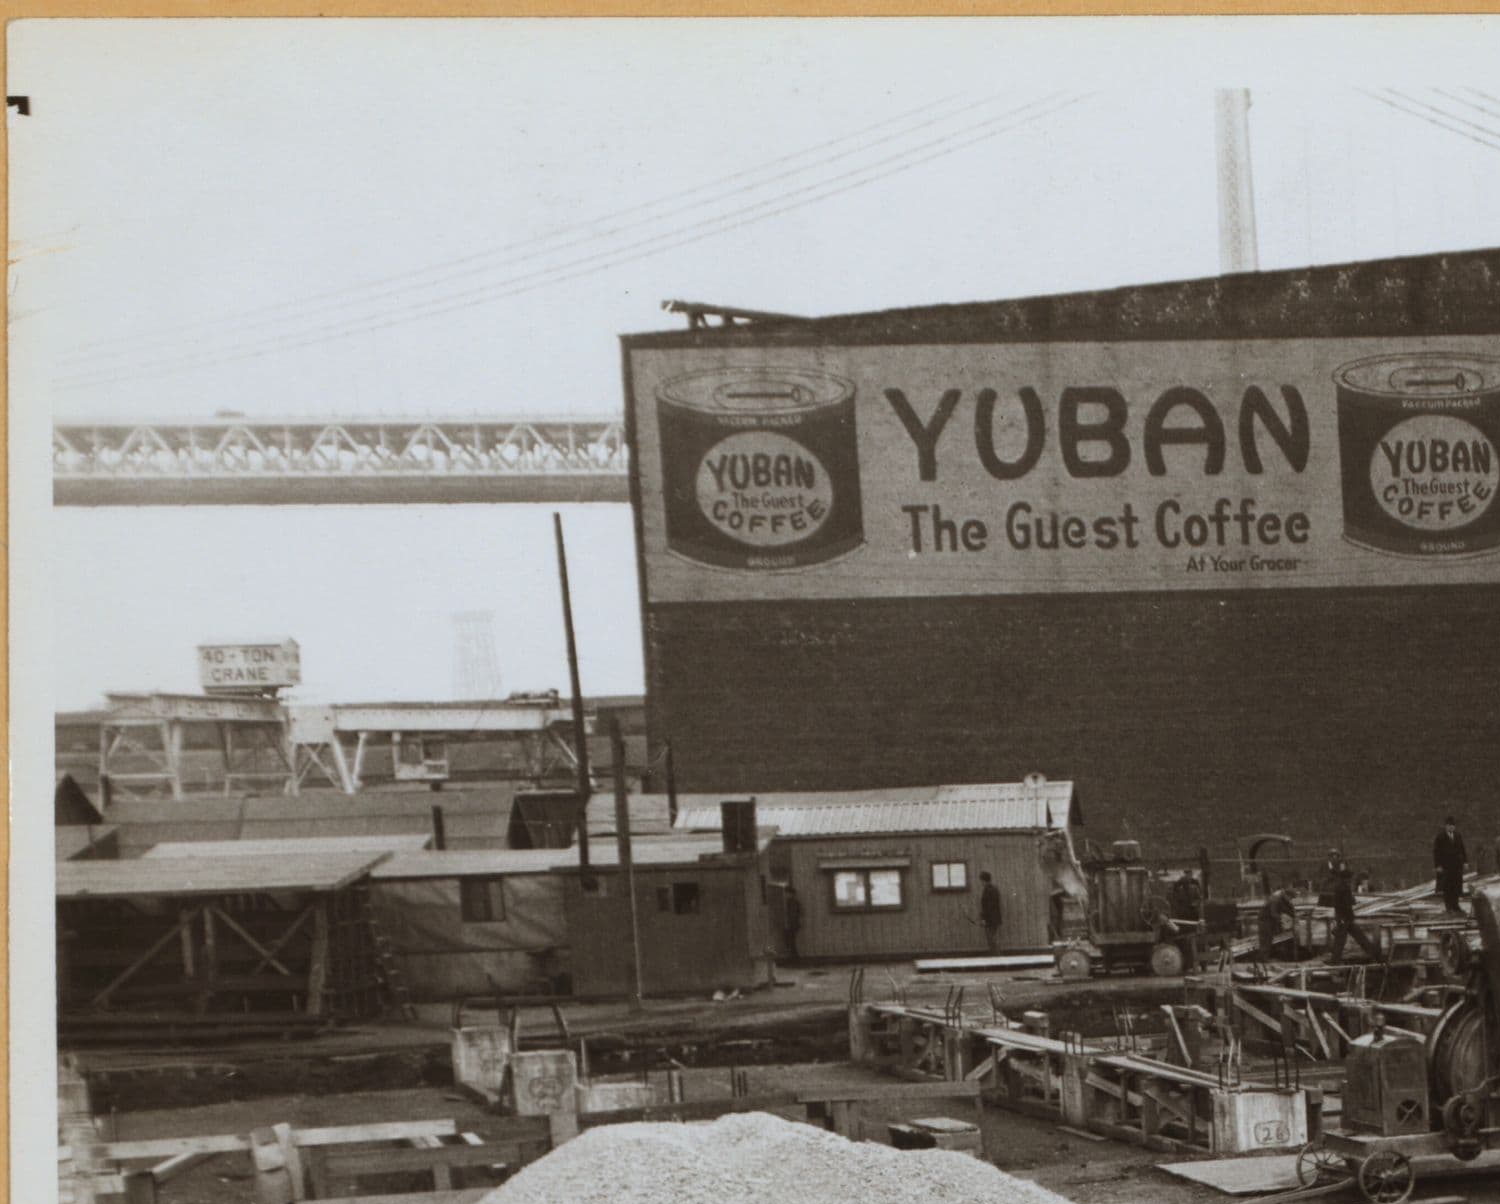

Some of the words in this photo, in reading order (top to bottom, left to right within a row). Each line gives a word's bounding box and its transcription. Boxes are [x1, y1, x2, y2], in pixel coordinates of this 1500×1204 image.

[883, 383, 1310, 482] YUBAN
[706, 453, 815, 493] YUBAN
[1380, 439, 1491, 478] YUBAN
[732, 492, 759, 509] The
[761, 491, 803, 509] Guest
[1383, 481, 1492, 521] COFFEE
[1402, 478, 1428, 495] The
[1430, 478, 1470, 495] Guest
[712, 498, 826, 533] COFFEE
[903, 504, 987, 553] The
[1006, 501, 1139, 551] Guest
[1156, 498, 1311, 549] Coffee
[1186, 555, 1206, 573] At
[1210, 554, 1246, 572] Your
[211, 667, 269, 682] CRANE
